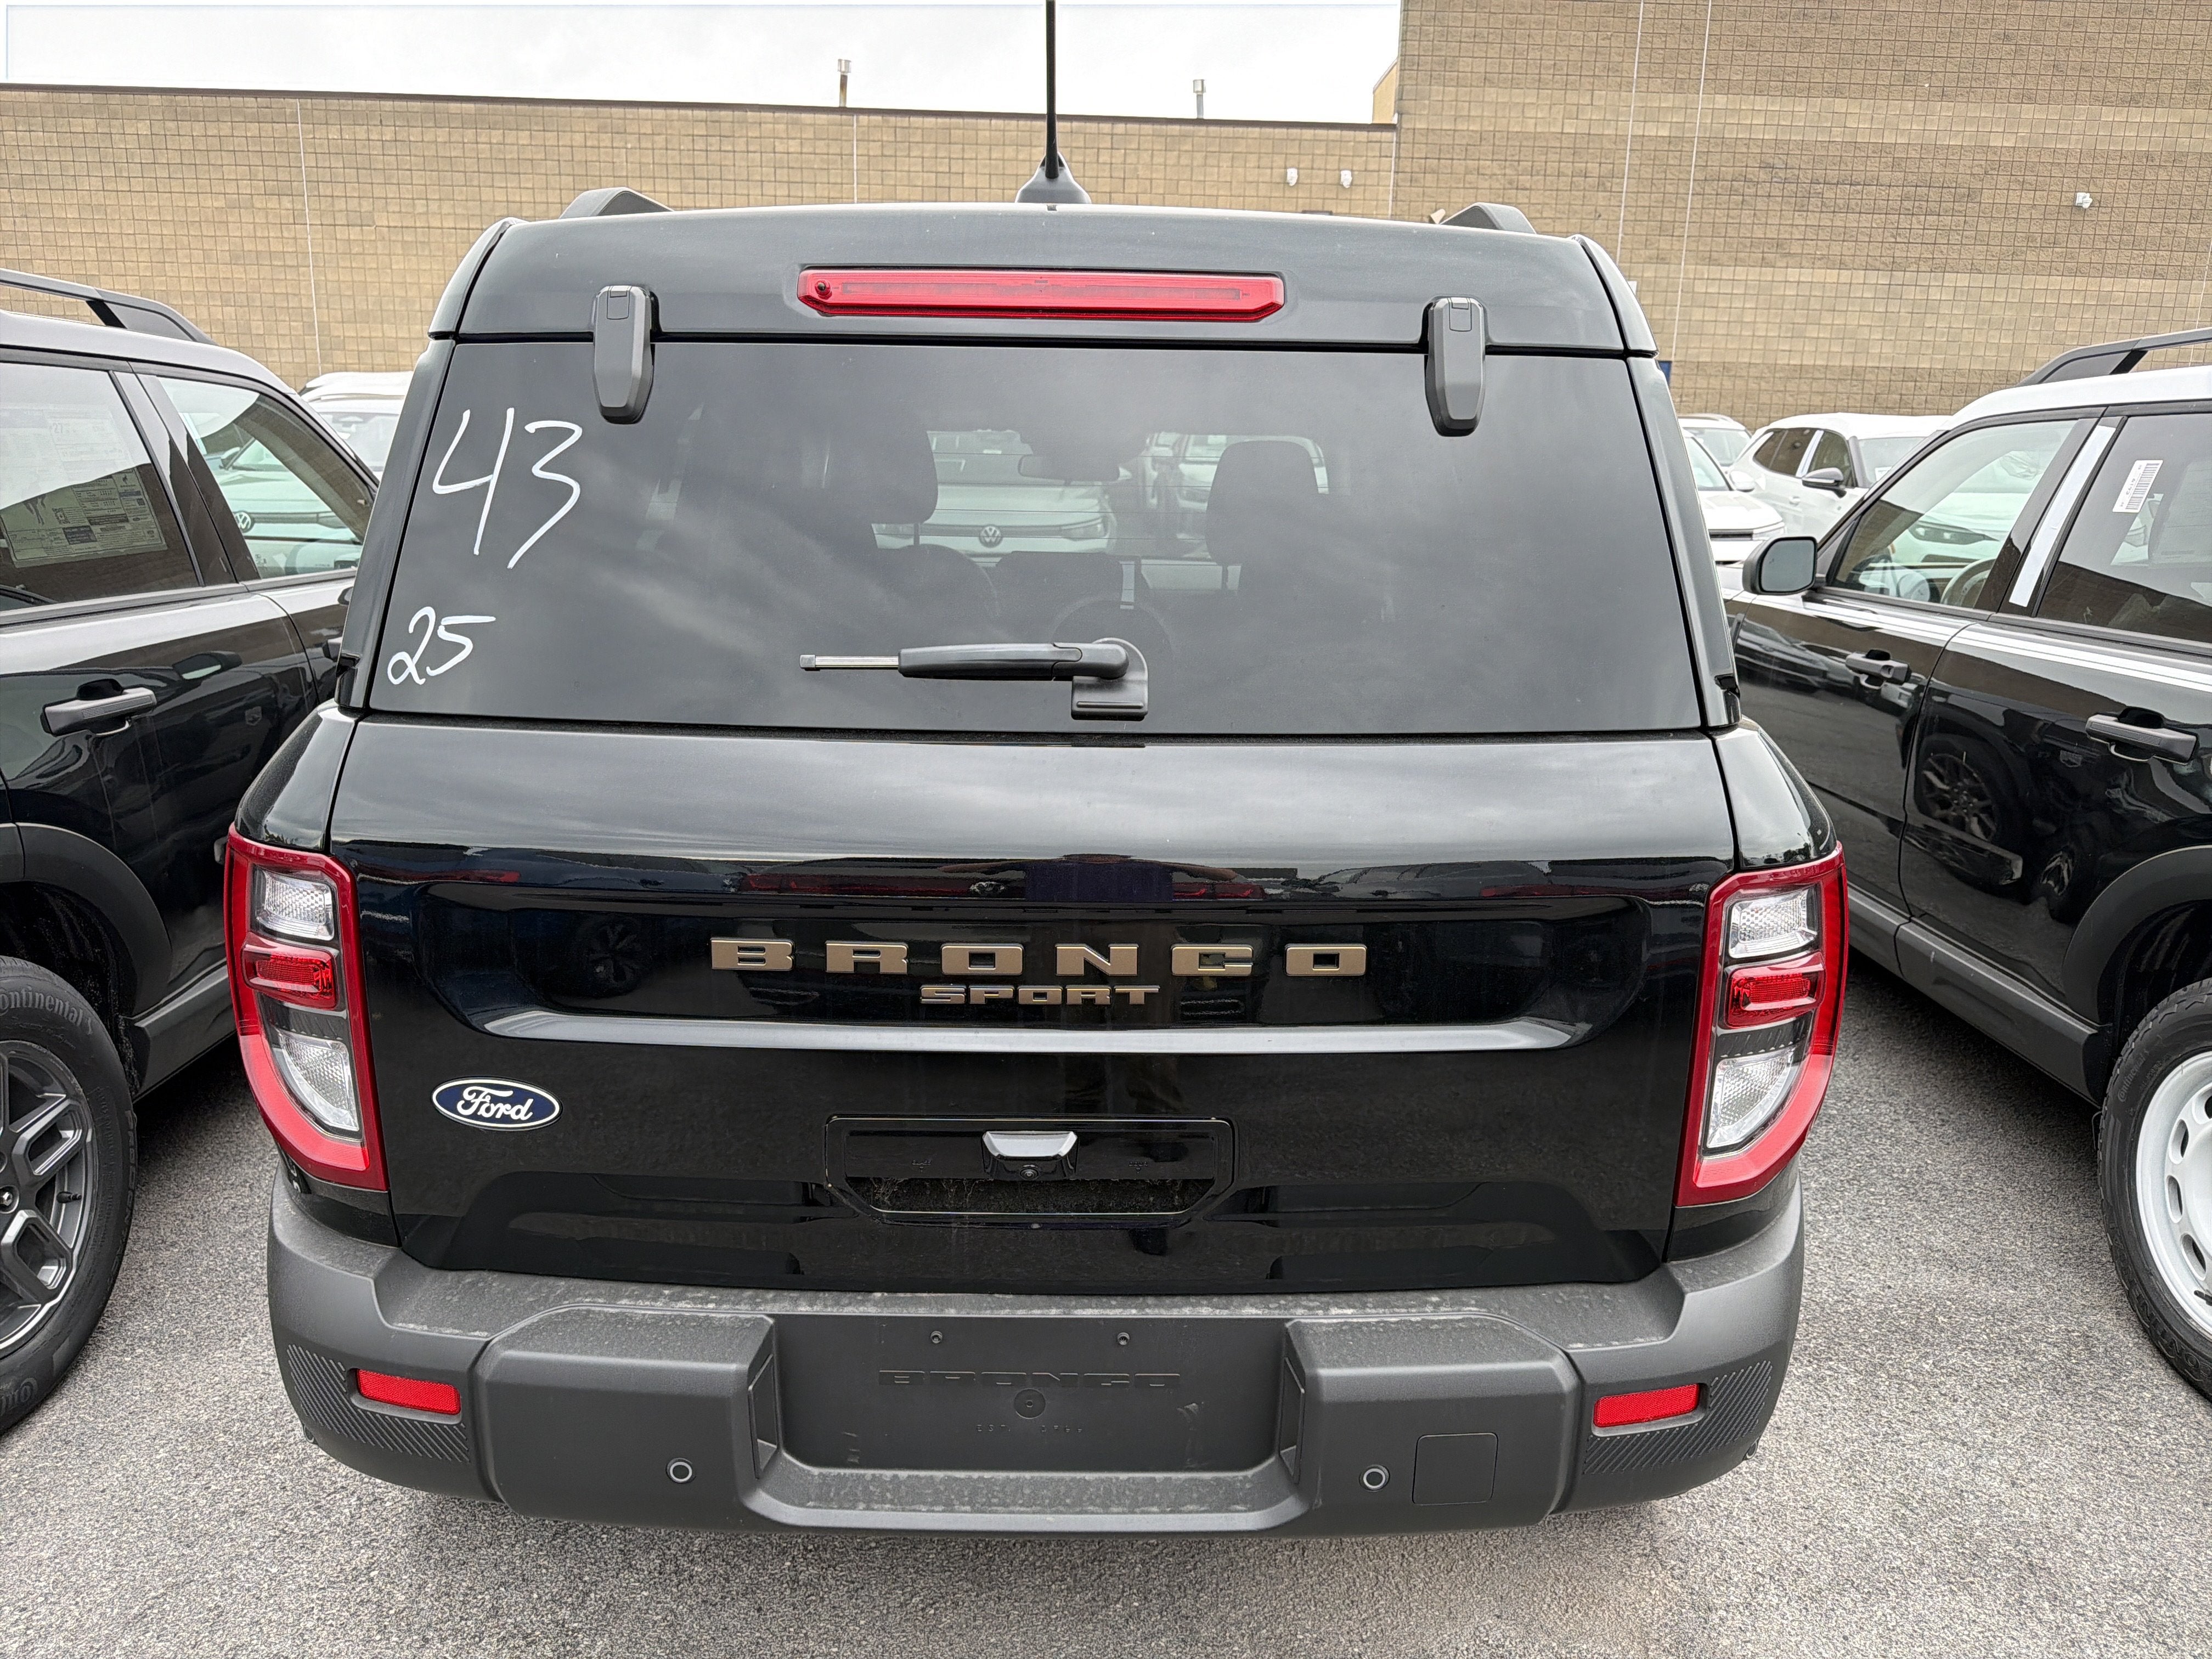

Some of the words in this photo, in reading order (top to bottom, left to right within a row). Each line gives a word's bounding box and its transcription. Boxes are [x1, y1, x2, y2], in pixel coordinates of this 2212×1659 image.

[432, 407, 583, 569] 43
[387, 606, 496, 685] 25
[709, 937, 1368, 978] BRONCO
[919, 984, 1161, 1006] SPORT
[456, 1086, 533, 1121] Ford
[879, 1370, 1181, 1388] BRONCO
